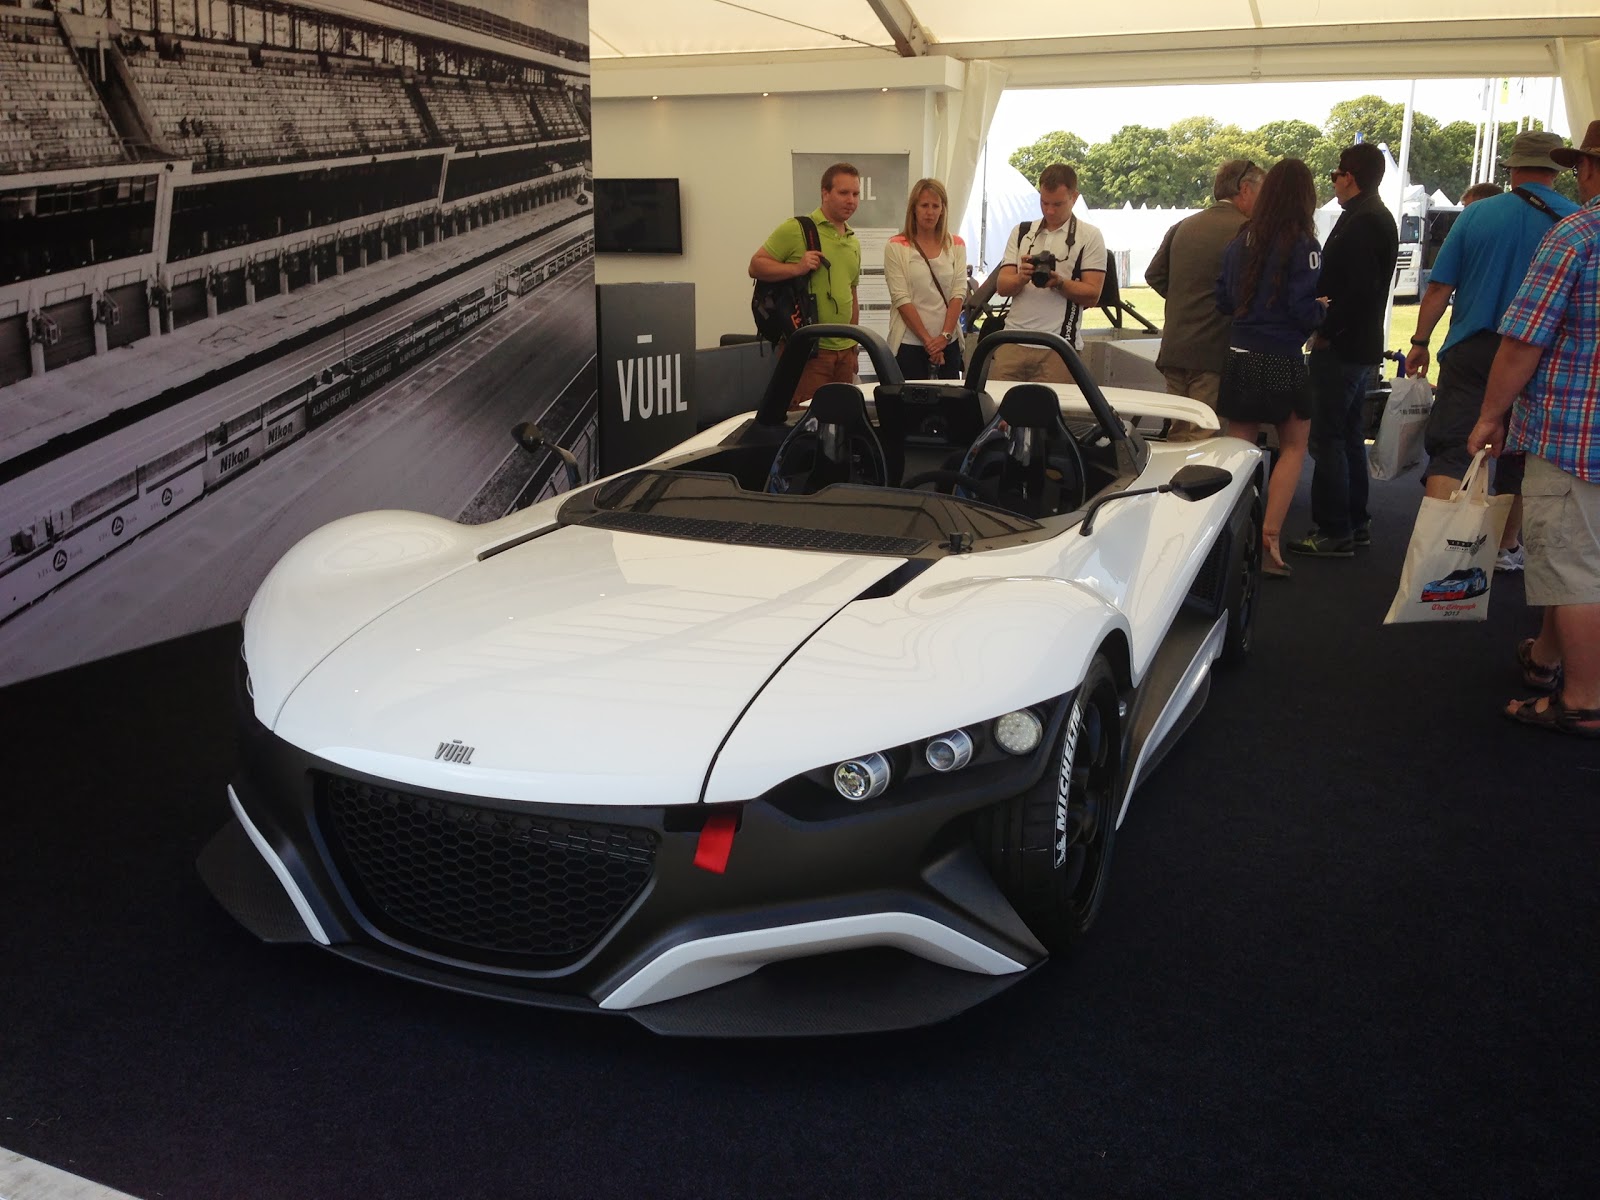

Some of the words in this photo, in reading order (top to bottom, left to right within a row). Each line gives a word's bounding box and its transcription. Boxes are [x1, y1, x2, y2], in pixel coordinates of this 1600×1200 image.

[267, 421, 293, 445] Nikon
[219, 446, 250, 474] Nikon
[1056, 703, 1082, 831] MICHELIN
